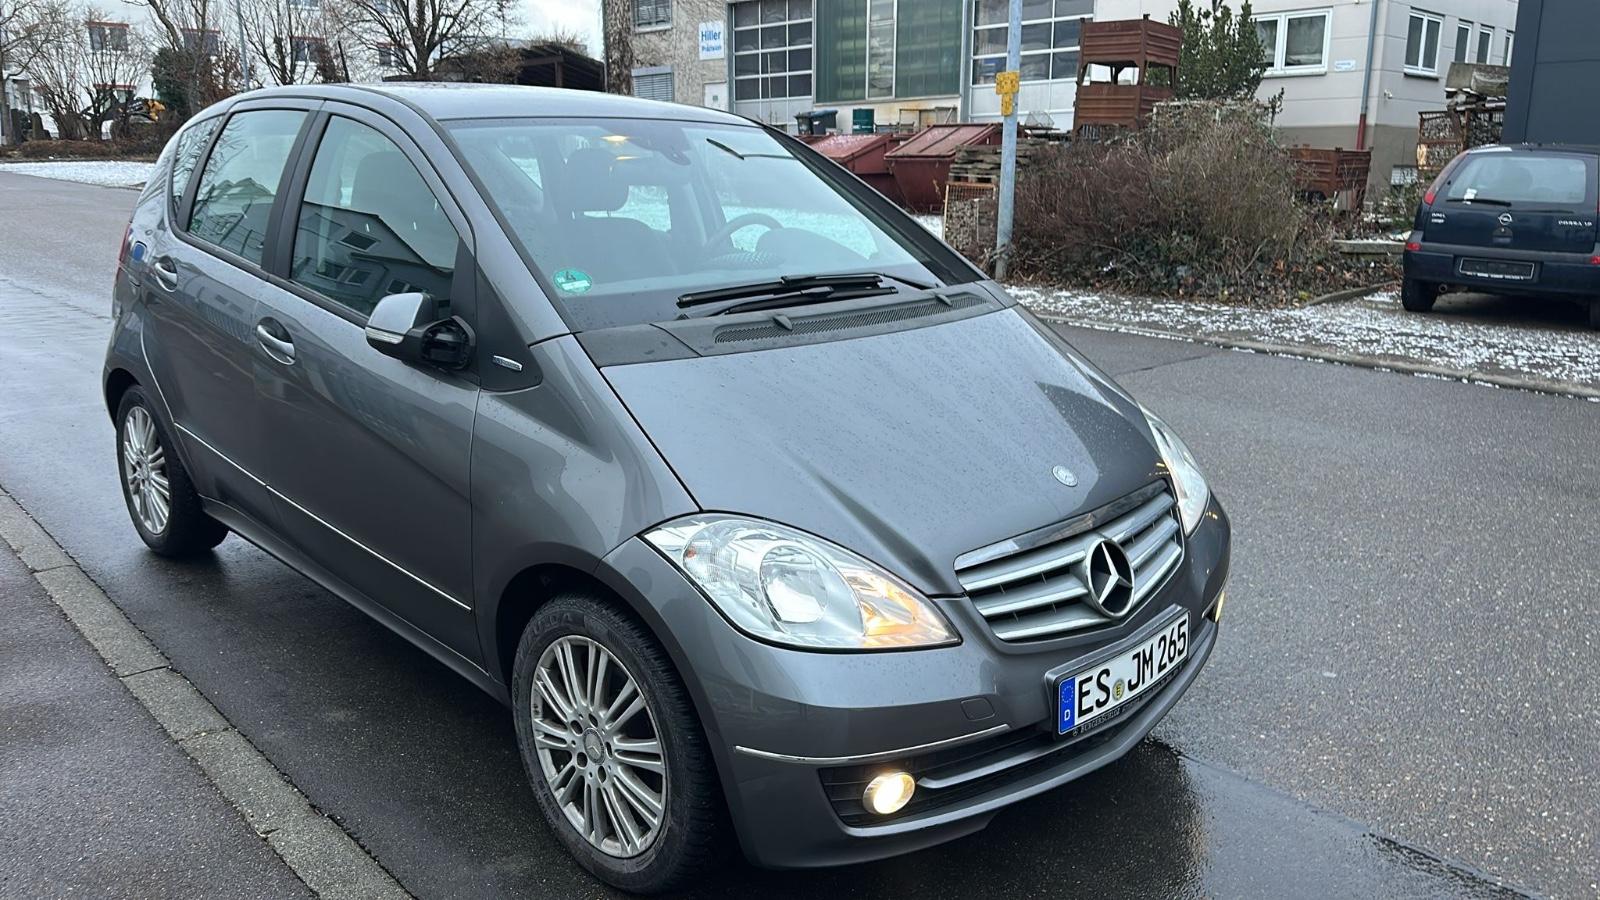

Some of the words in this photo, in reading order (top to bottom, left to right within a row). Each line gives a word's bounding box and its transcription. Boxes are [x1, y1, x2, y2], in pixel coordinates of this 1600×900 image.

[701, 31, 721, 41] Hiller
[1077, 668, 1111, 719] ES
[1127, 643, 1154, 692] JM
[1157, 618, 1187, 675] 265
[1063, 709, 1071, 721] D
